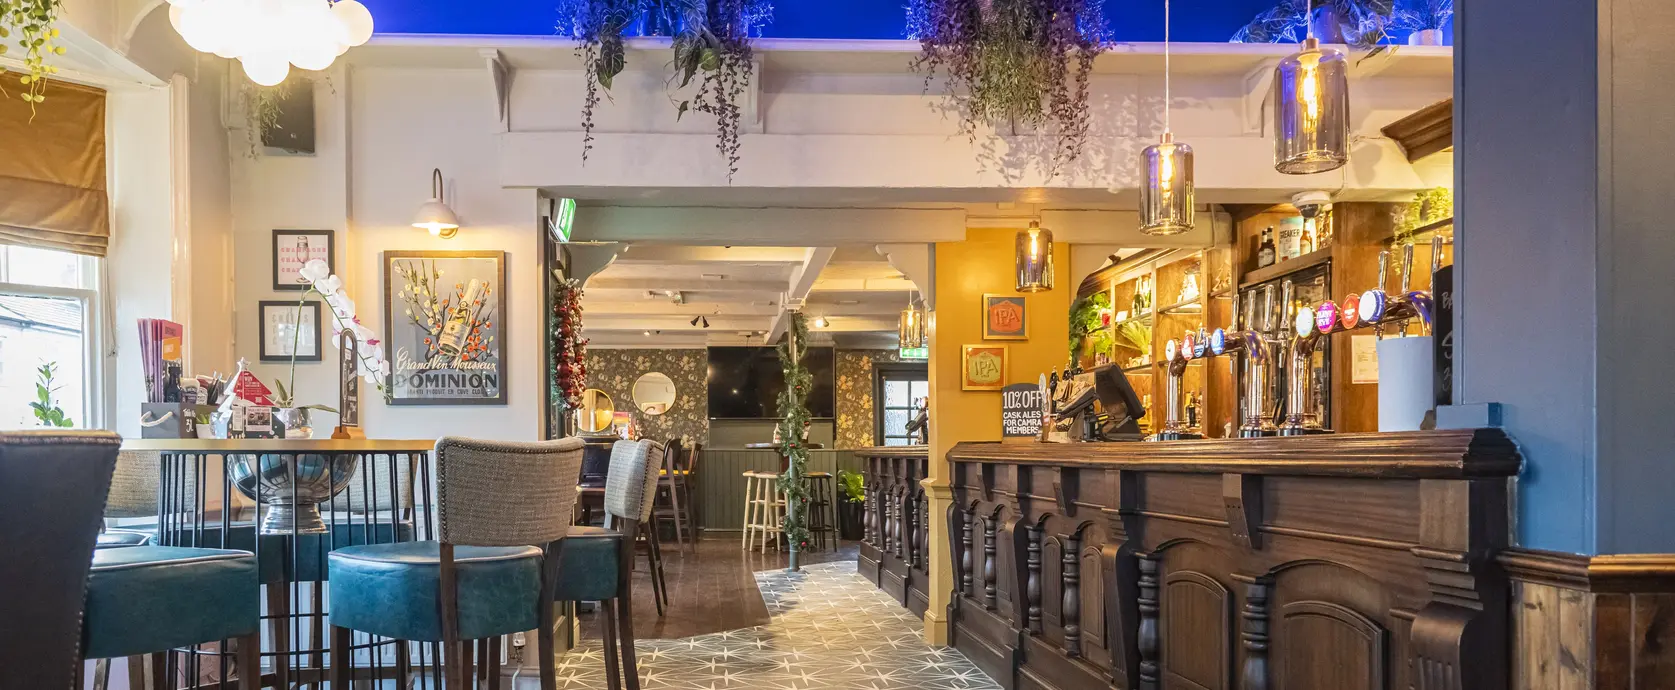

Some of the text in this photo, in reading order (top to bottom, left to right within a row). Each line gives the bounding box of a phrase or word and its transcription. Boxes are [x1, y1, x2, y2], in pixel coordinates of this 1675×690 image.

[995, 307, 1020, 325] IPA
[396, 346, 497, 374] Grand Vin Mousseux
[975, 358, 998, 376] IPA
[1003, 391, 1042, 409] 10% OFF
[1003, 410, 1042, 419] CASK ALES
[1017, 418, 1042, 426] CAMRA
[1006, 426, 1039, 434] MEMBERS
